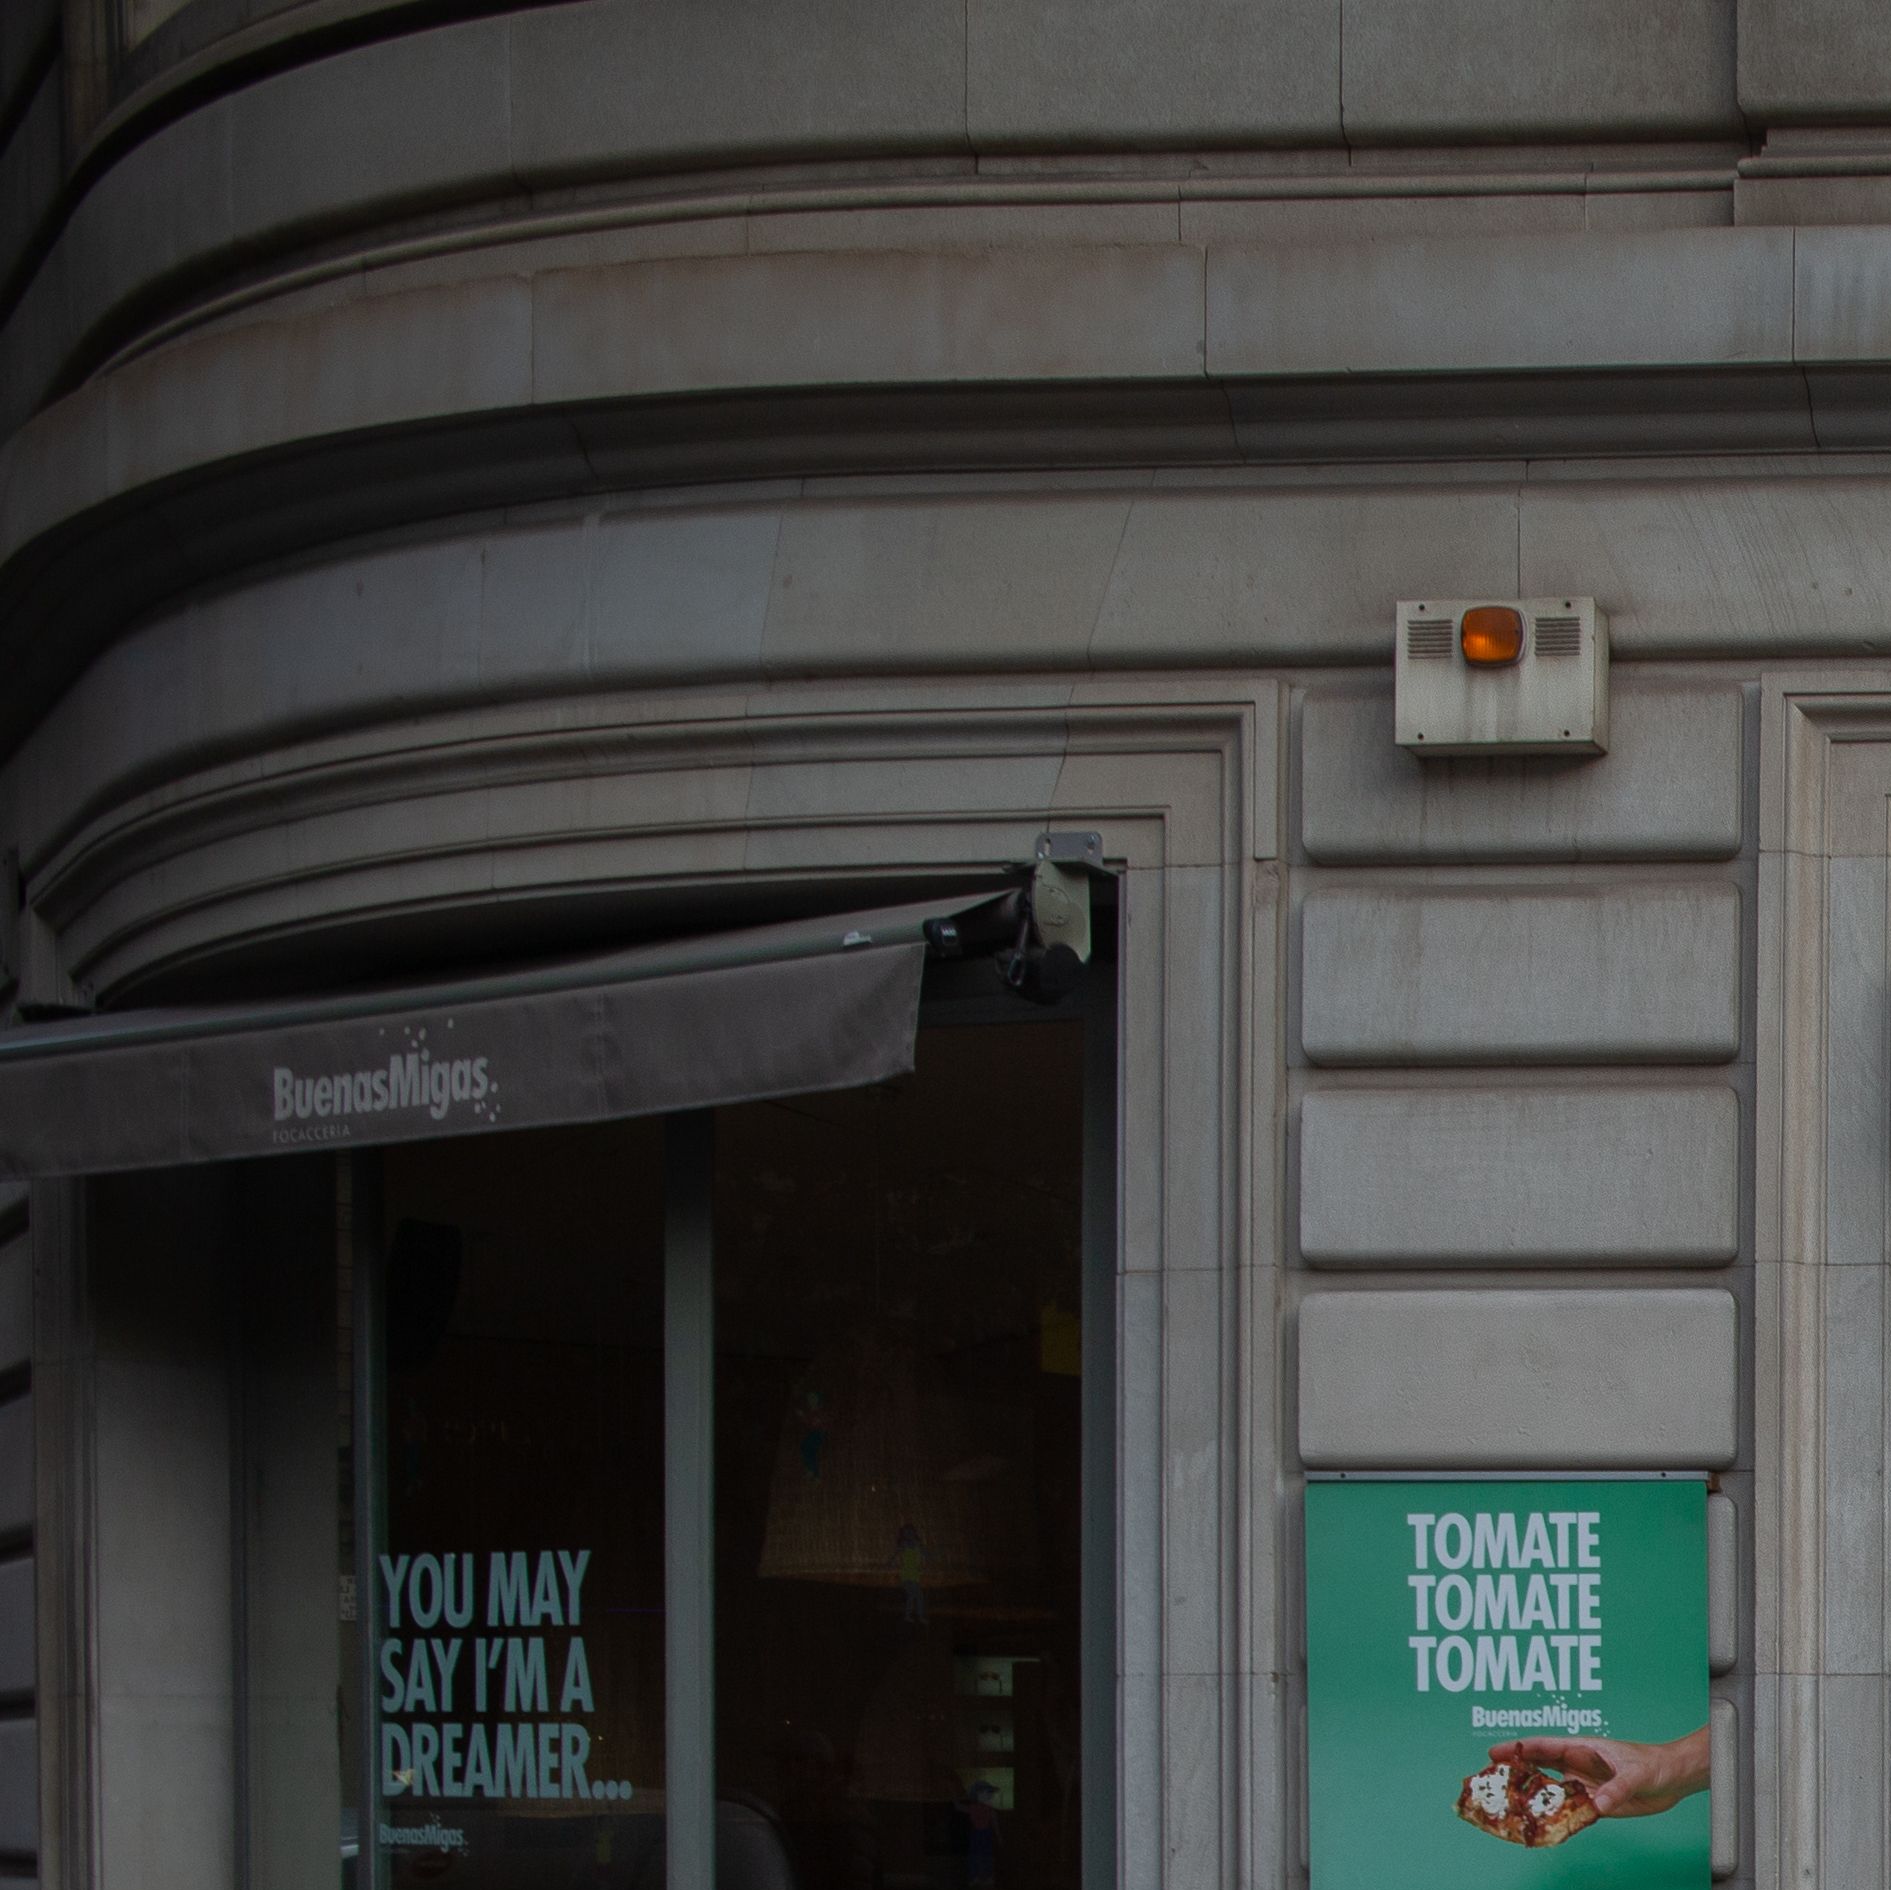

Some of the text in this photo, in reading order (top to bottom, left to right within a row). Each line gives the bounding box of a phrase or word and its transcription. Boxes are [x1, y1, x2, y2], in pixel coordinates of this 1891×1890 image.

[273, 1048, 489, 1121] BuenasMigas
[272, 1124, 351, 1144] FOCACCERIA
[1407, 1512, 1602, 1570] TOMATE
[379, 1549, 592, 1629] YOU MAY
[1407, 1573, 1602, 1631] TOMATE
[380, 1636, 595, 1714] SAY I'M A
[1408, 1635, 1603, 1692] TOMATE
[1471, 1703, 1602, 1735] BuenasMigas
[381, 1722, 633, 1800] DREAMER...
[377, 1823, 464, 1853] BuenasMigas
